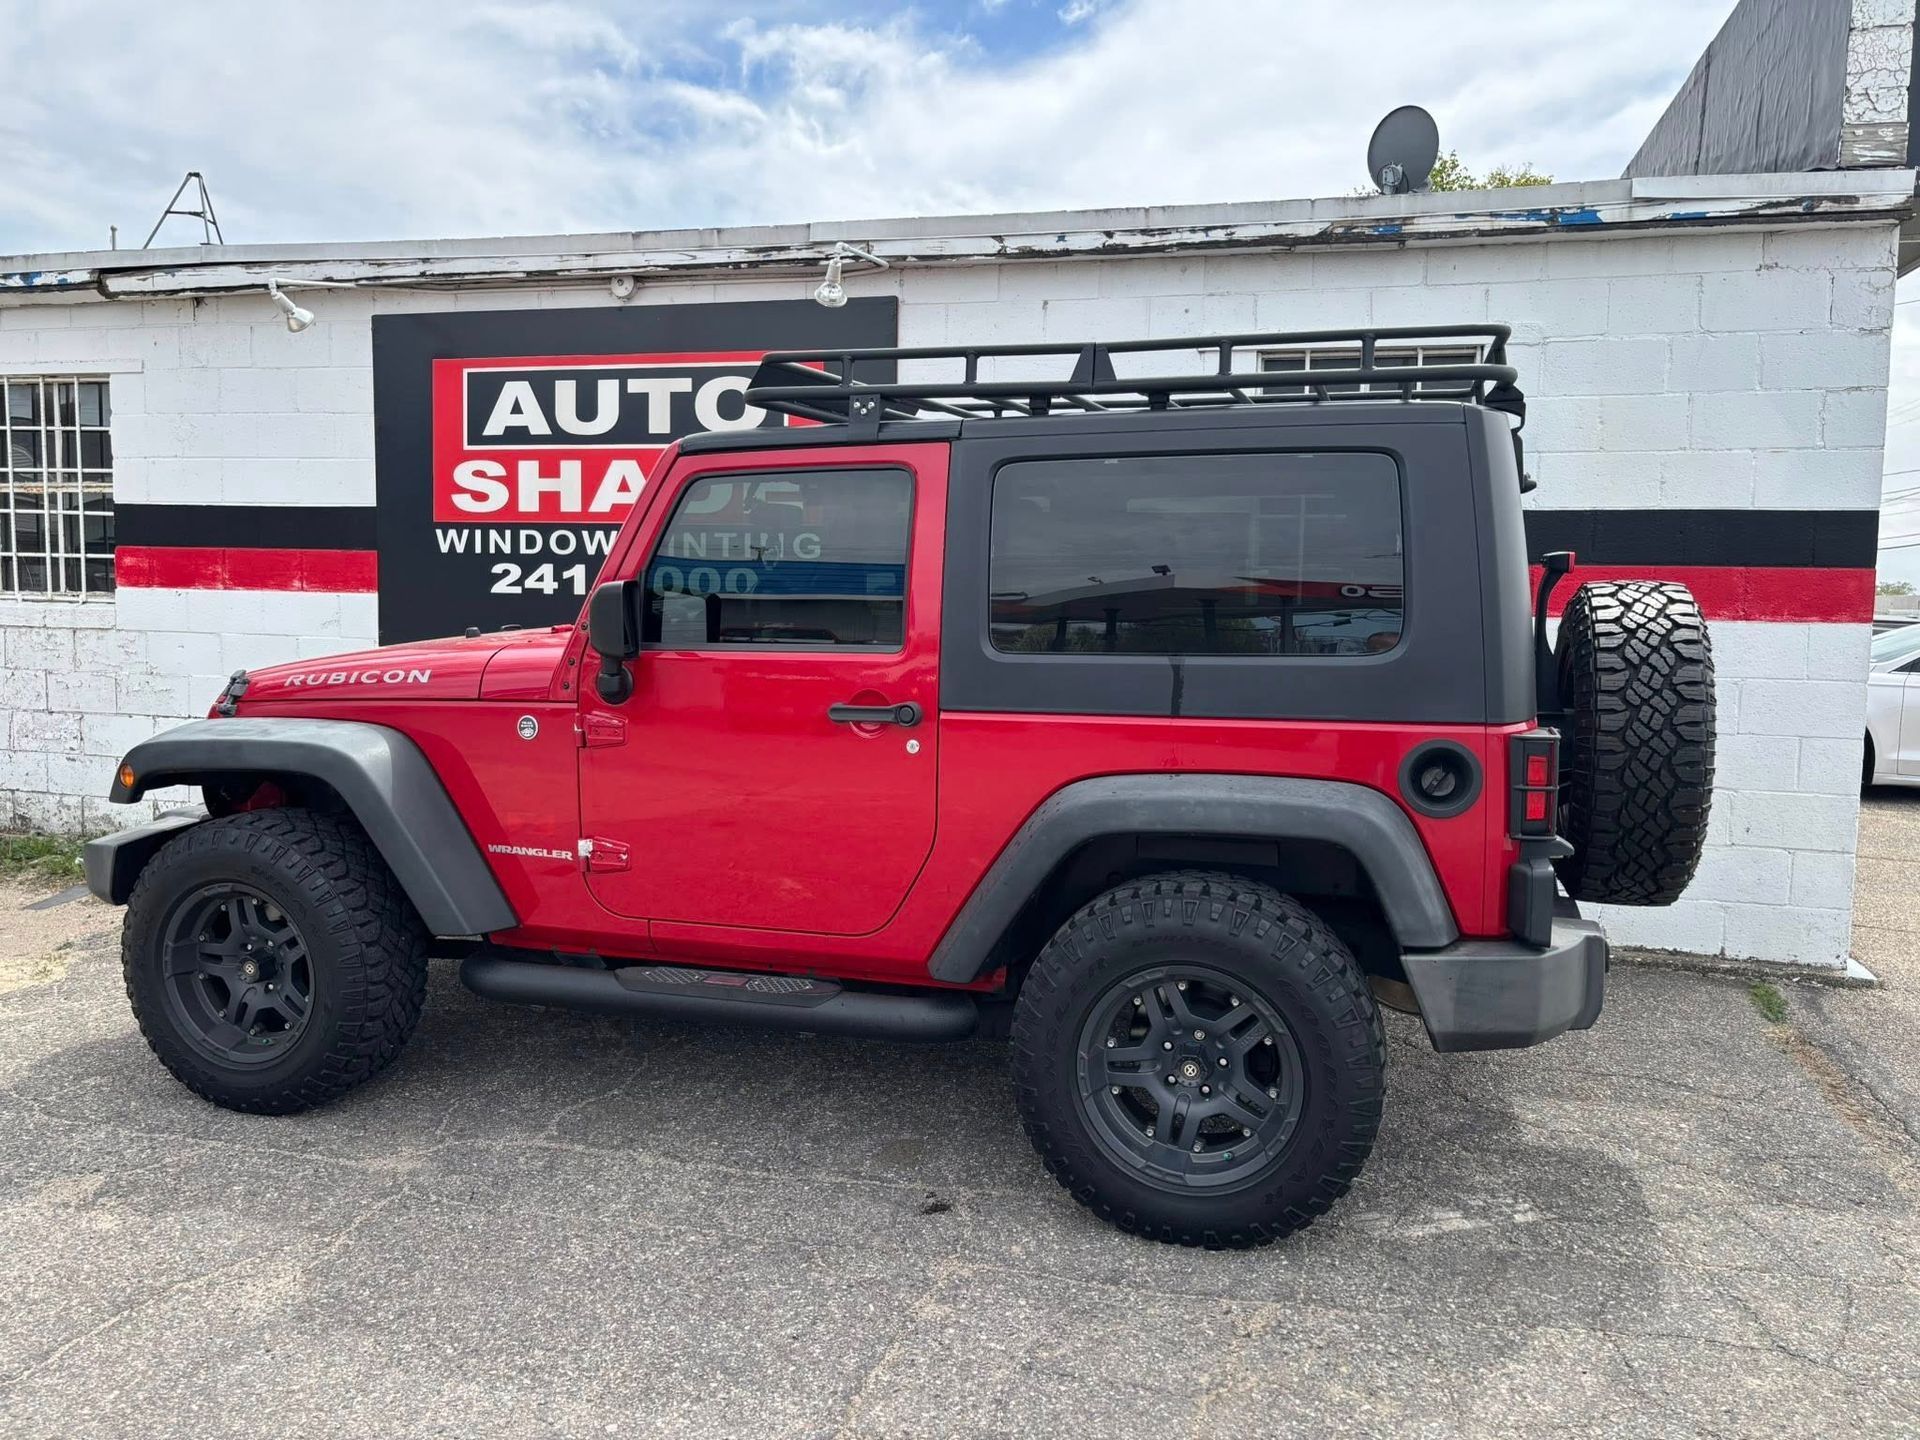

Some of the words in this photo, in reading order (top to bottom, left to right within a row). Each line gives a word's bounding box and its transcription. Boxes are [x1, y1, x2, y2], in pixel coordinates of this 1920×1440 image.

[482, 375, 768, 436] AUTO
[435, 529, 618, 556] WINDOW
[284, 669, 432, 687] RUBICON
[487, 844, 573, 861] WRANGLER
